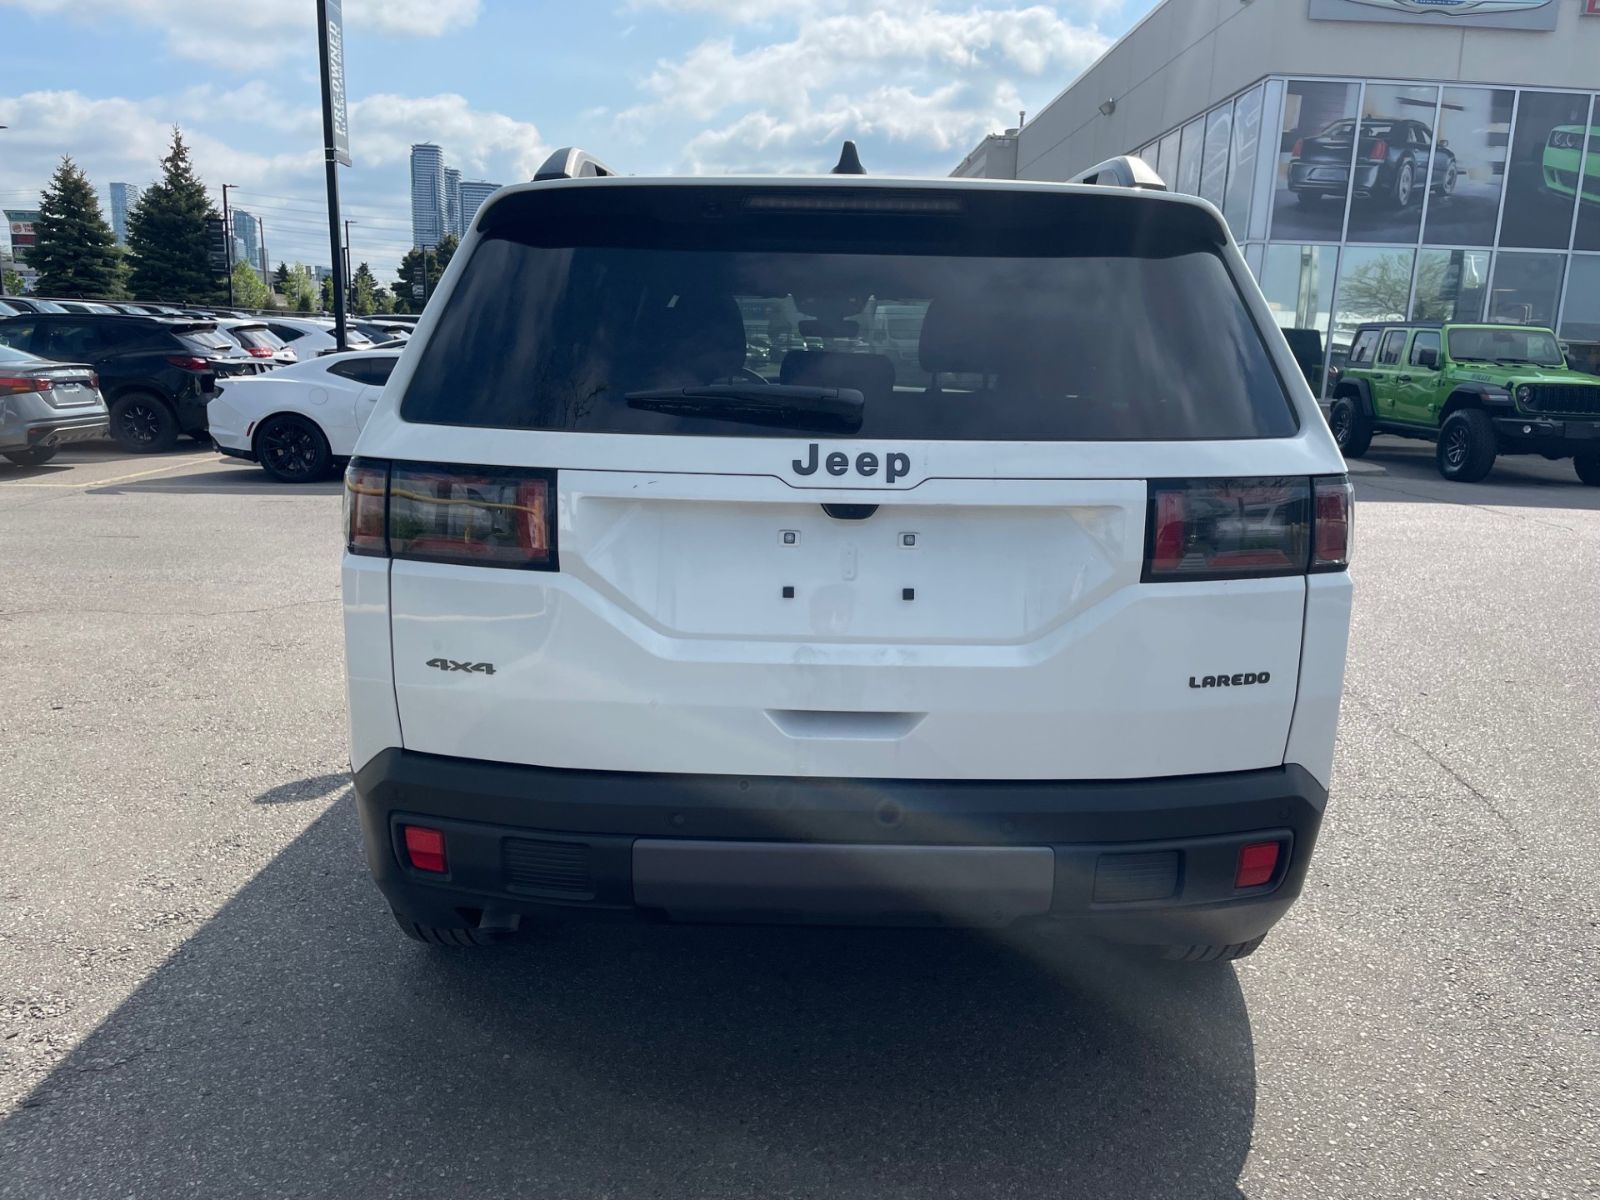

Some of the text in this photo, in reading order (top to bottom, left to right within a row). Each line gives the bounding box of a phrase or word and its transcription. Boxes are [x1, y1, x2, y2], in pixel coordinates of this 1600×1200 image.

[329, 20, 342, 136] PRE-OWNED
[792, 443, 911, 484] Jeep
[425, 657, 497, 675] 4x4
[1189, 671, 1271, 689] LAREDO
